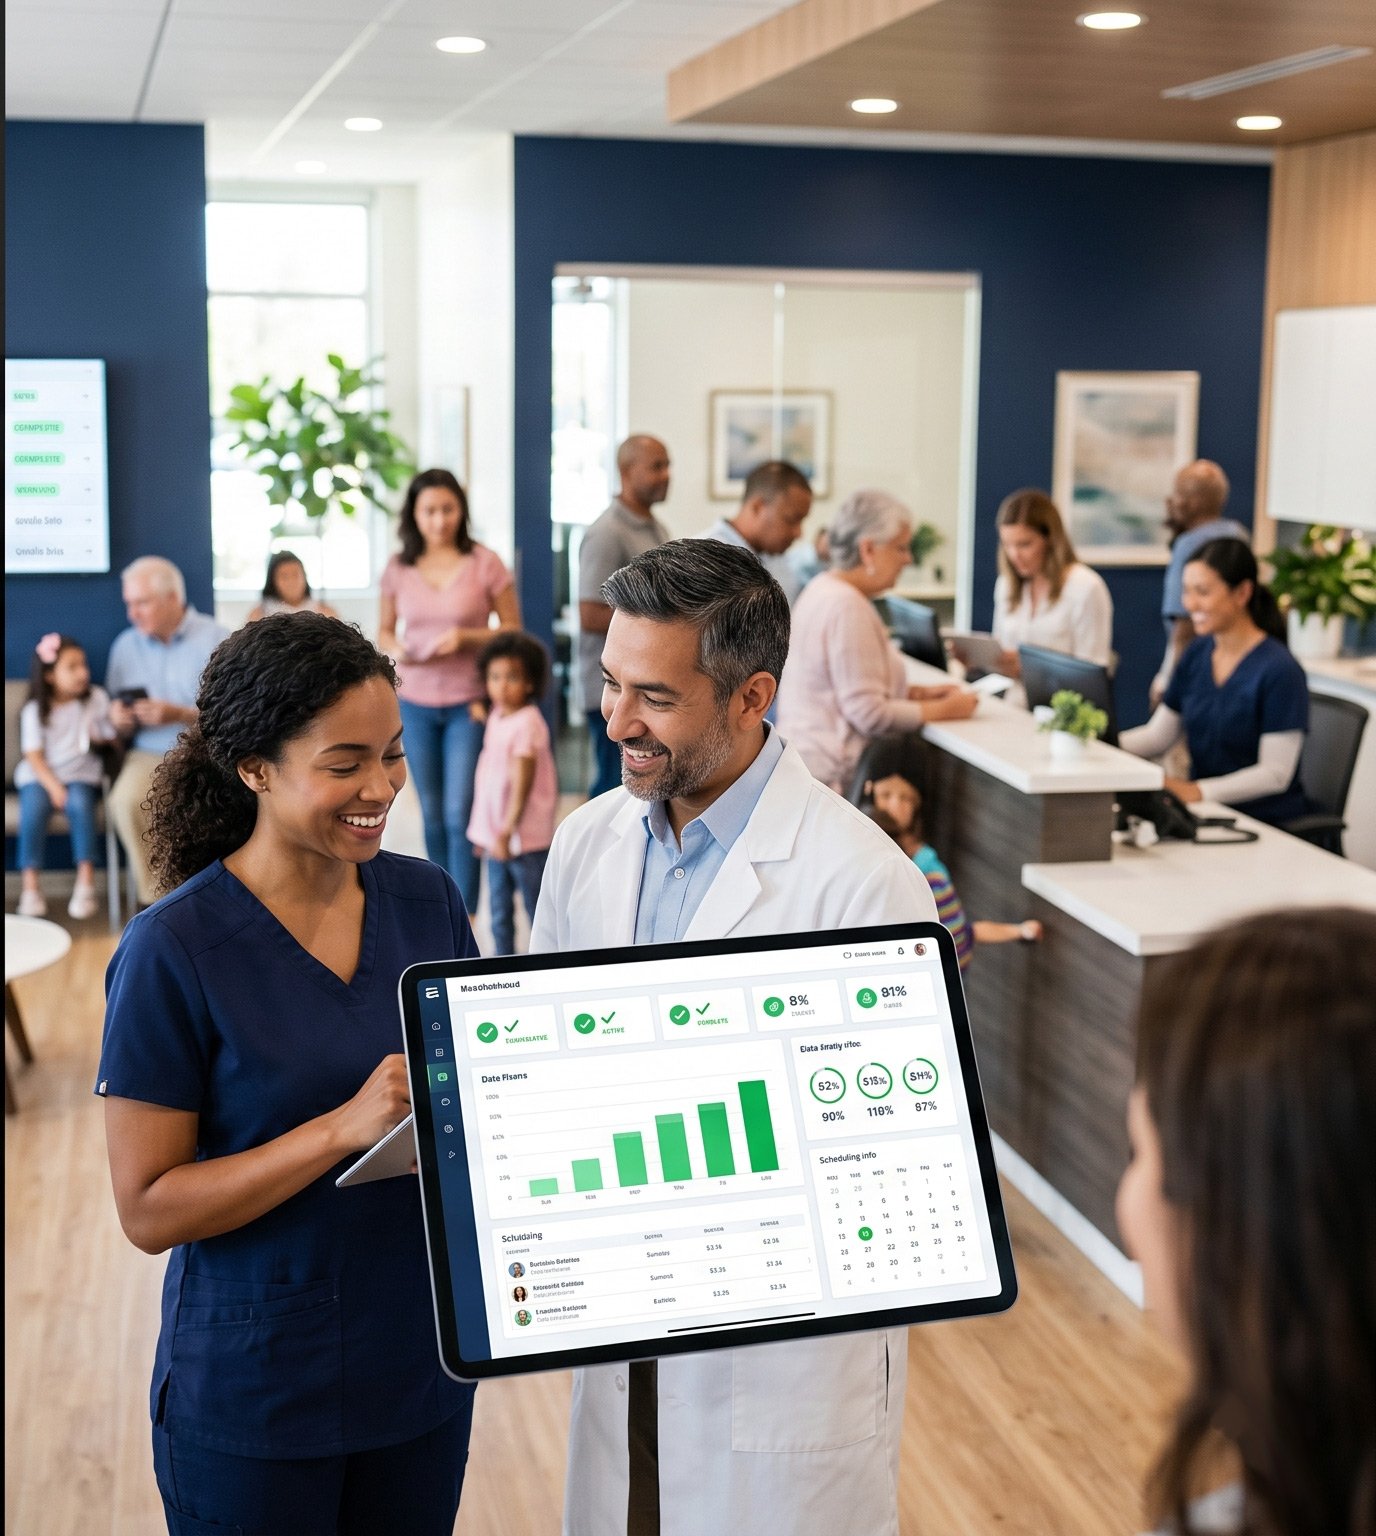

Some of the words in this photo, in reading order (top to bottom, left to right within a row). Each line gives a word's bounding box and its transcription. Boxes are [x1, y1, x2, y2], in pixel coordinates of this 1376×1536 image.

[789, 995, 808, 1006] 8%
[822, 1111, 844, 1121] 90%
[820, 1154, 860, 1164] Scheduling
